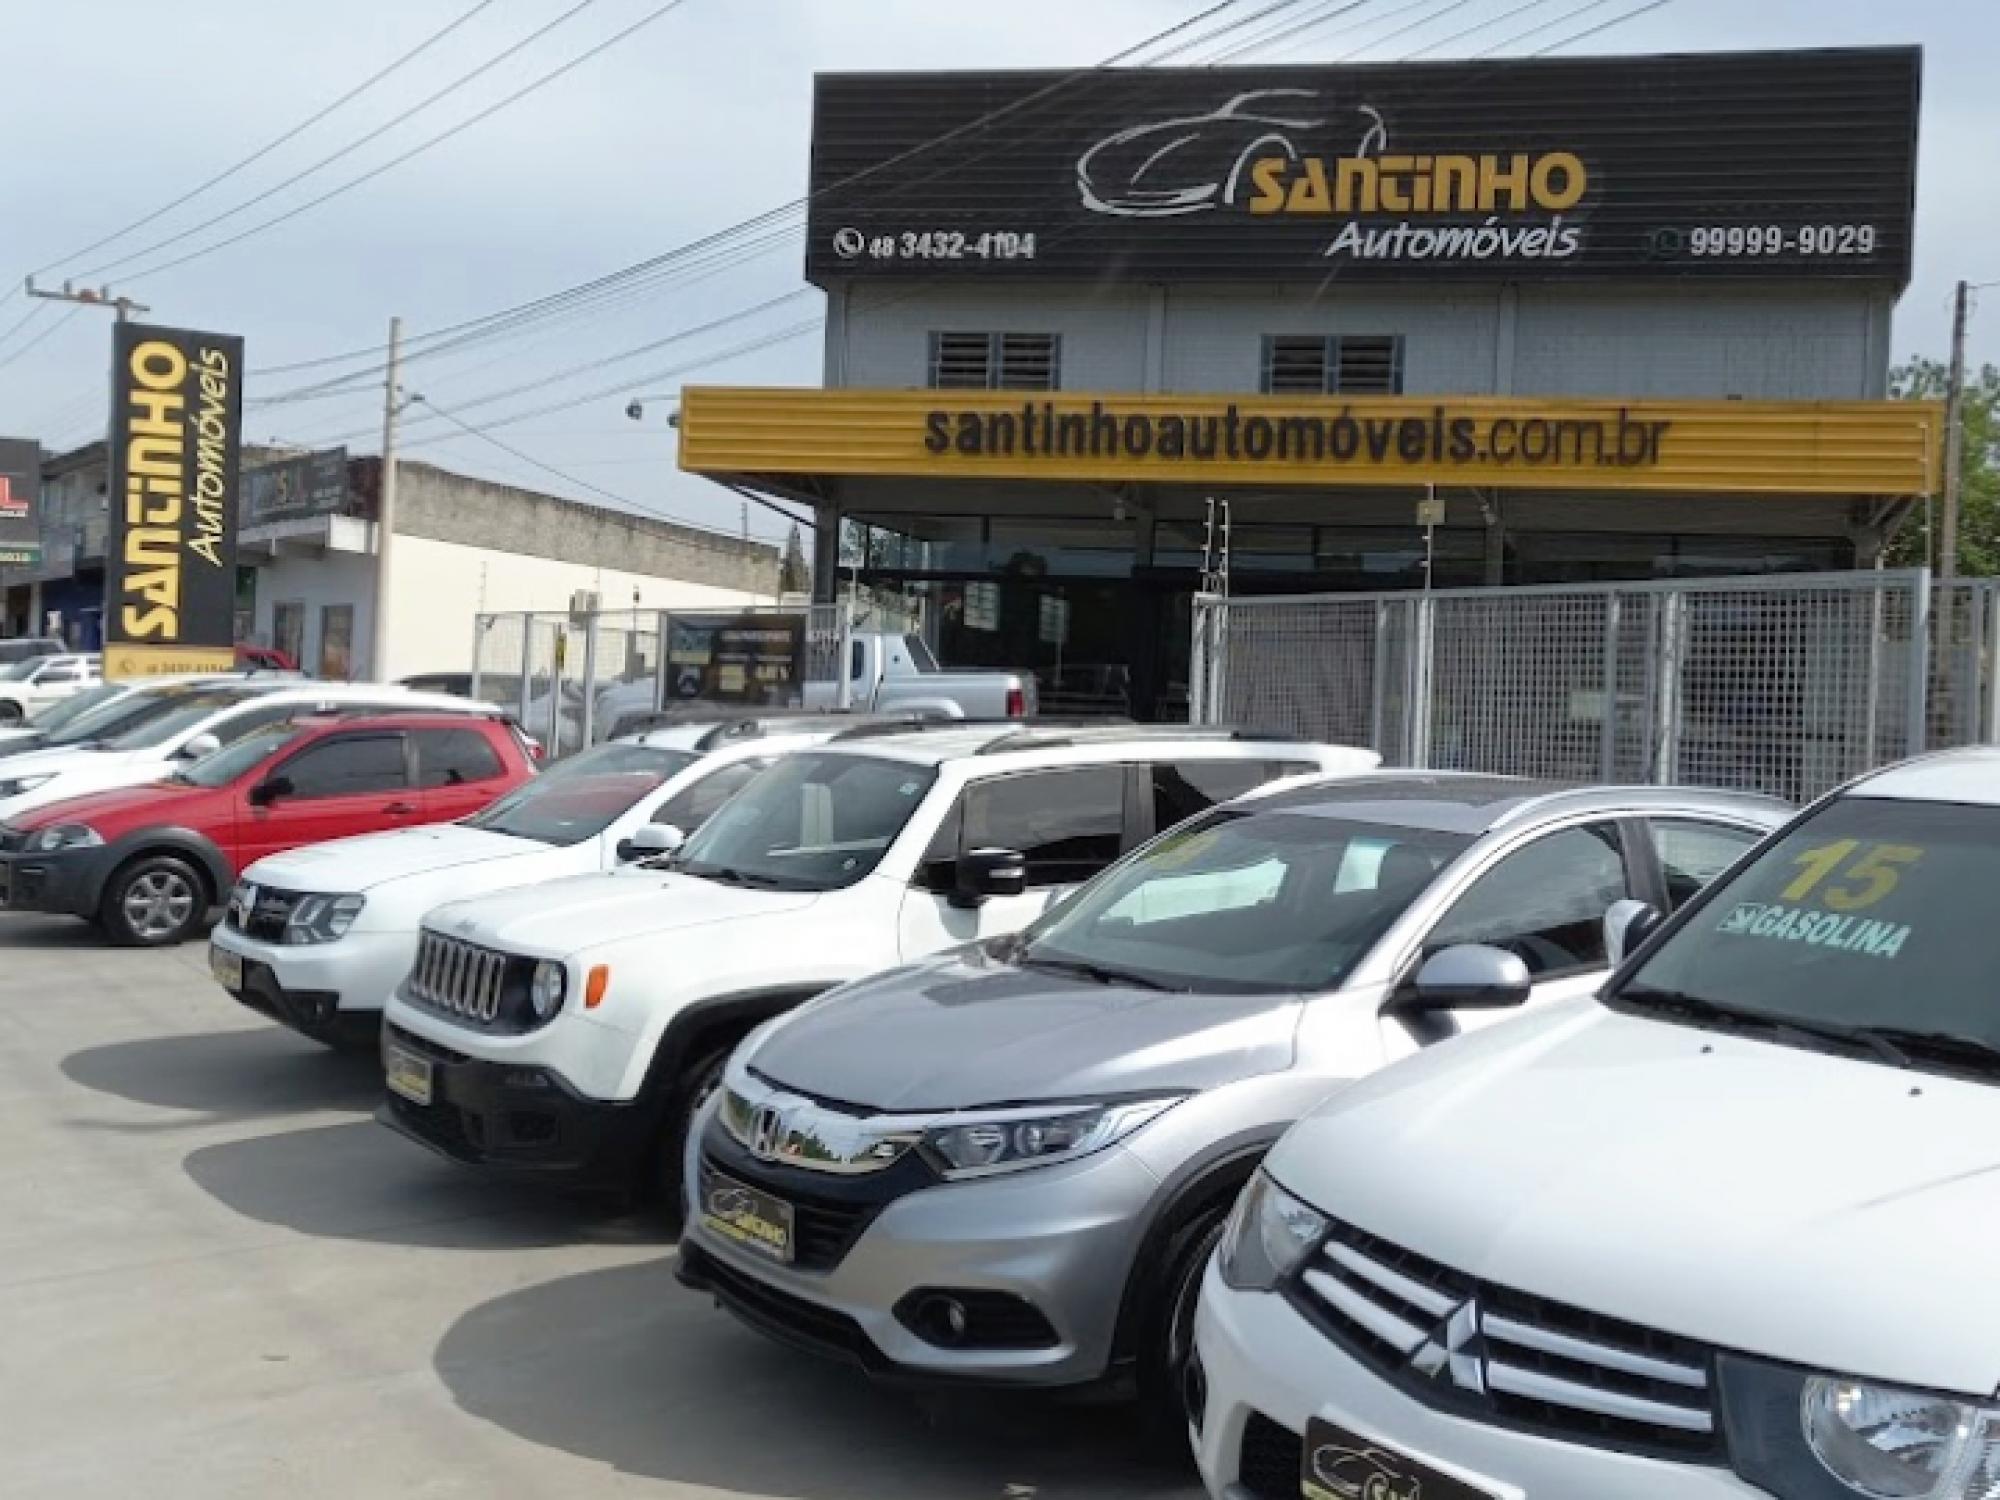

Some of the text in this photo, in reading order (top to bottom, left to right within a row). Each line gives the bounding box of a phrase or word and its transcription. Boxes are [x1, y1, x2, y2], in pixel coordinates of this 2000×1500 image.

[868, 237, 896, 259] 48
[1324, 215, 1583, 259] Automóveis
[1689, 225, 1875, 256] 99999-9029
[188, 346, 229, 568] Automóveis
[924, 401, 1671, 466] santinhoautomóveis.com.br
[1780, 838, 1926, 910] 15
[1750, 904, 1912, 959] GASOLINA
